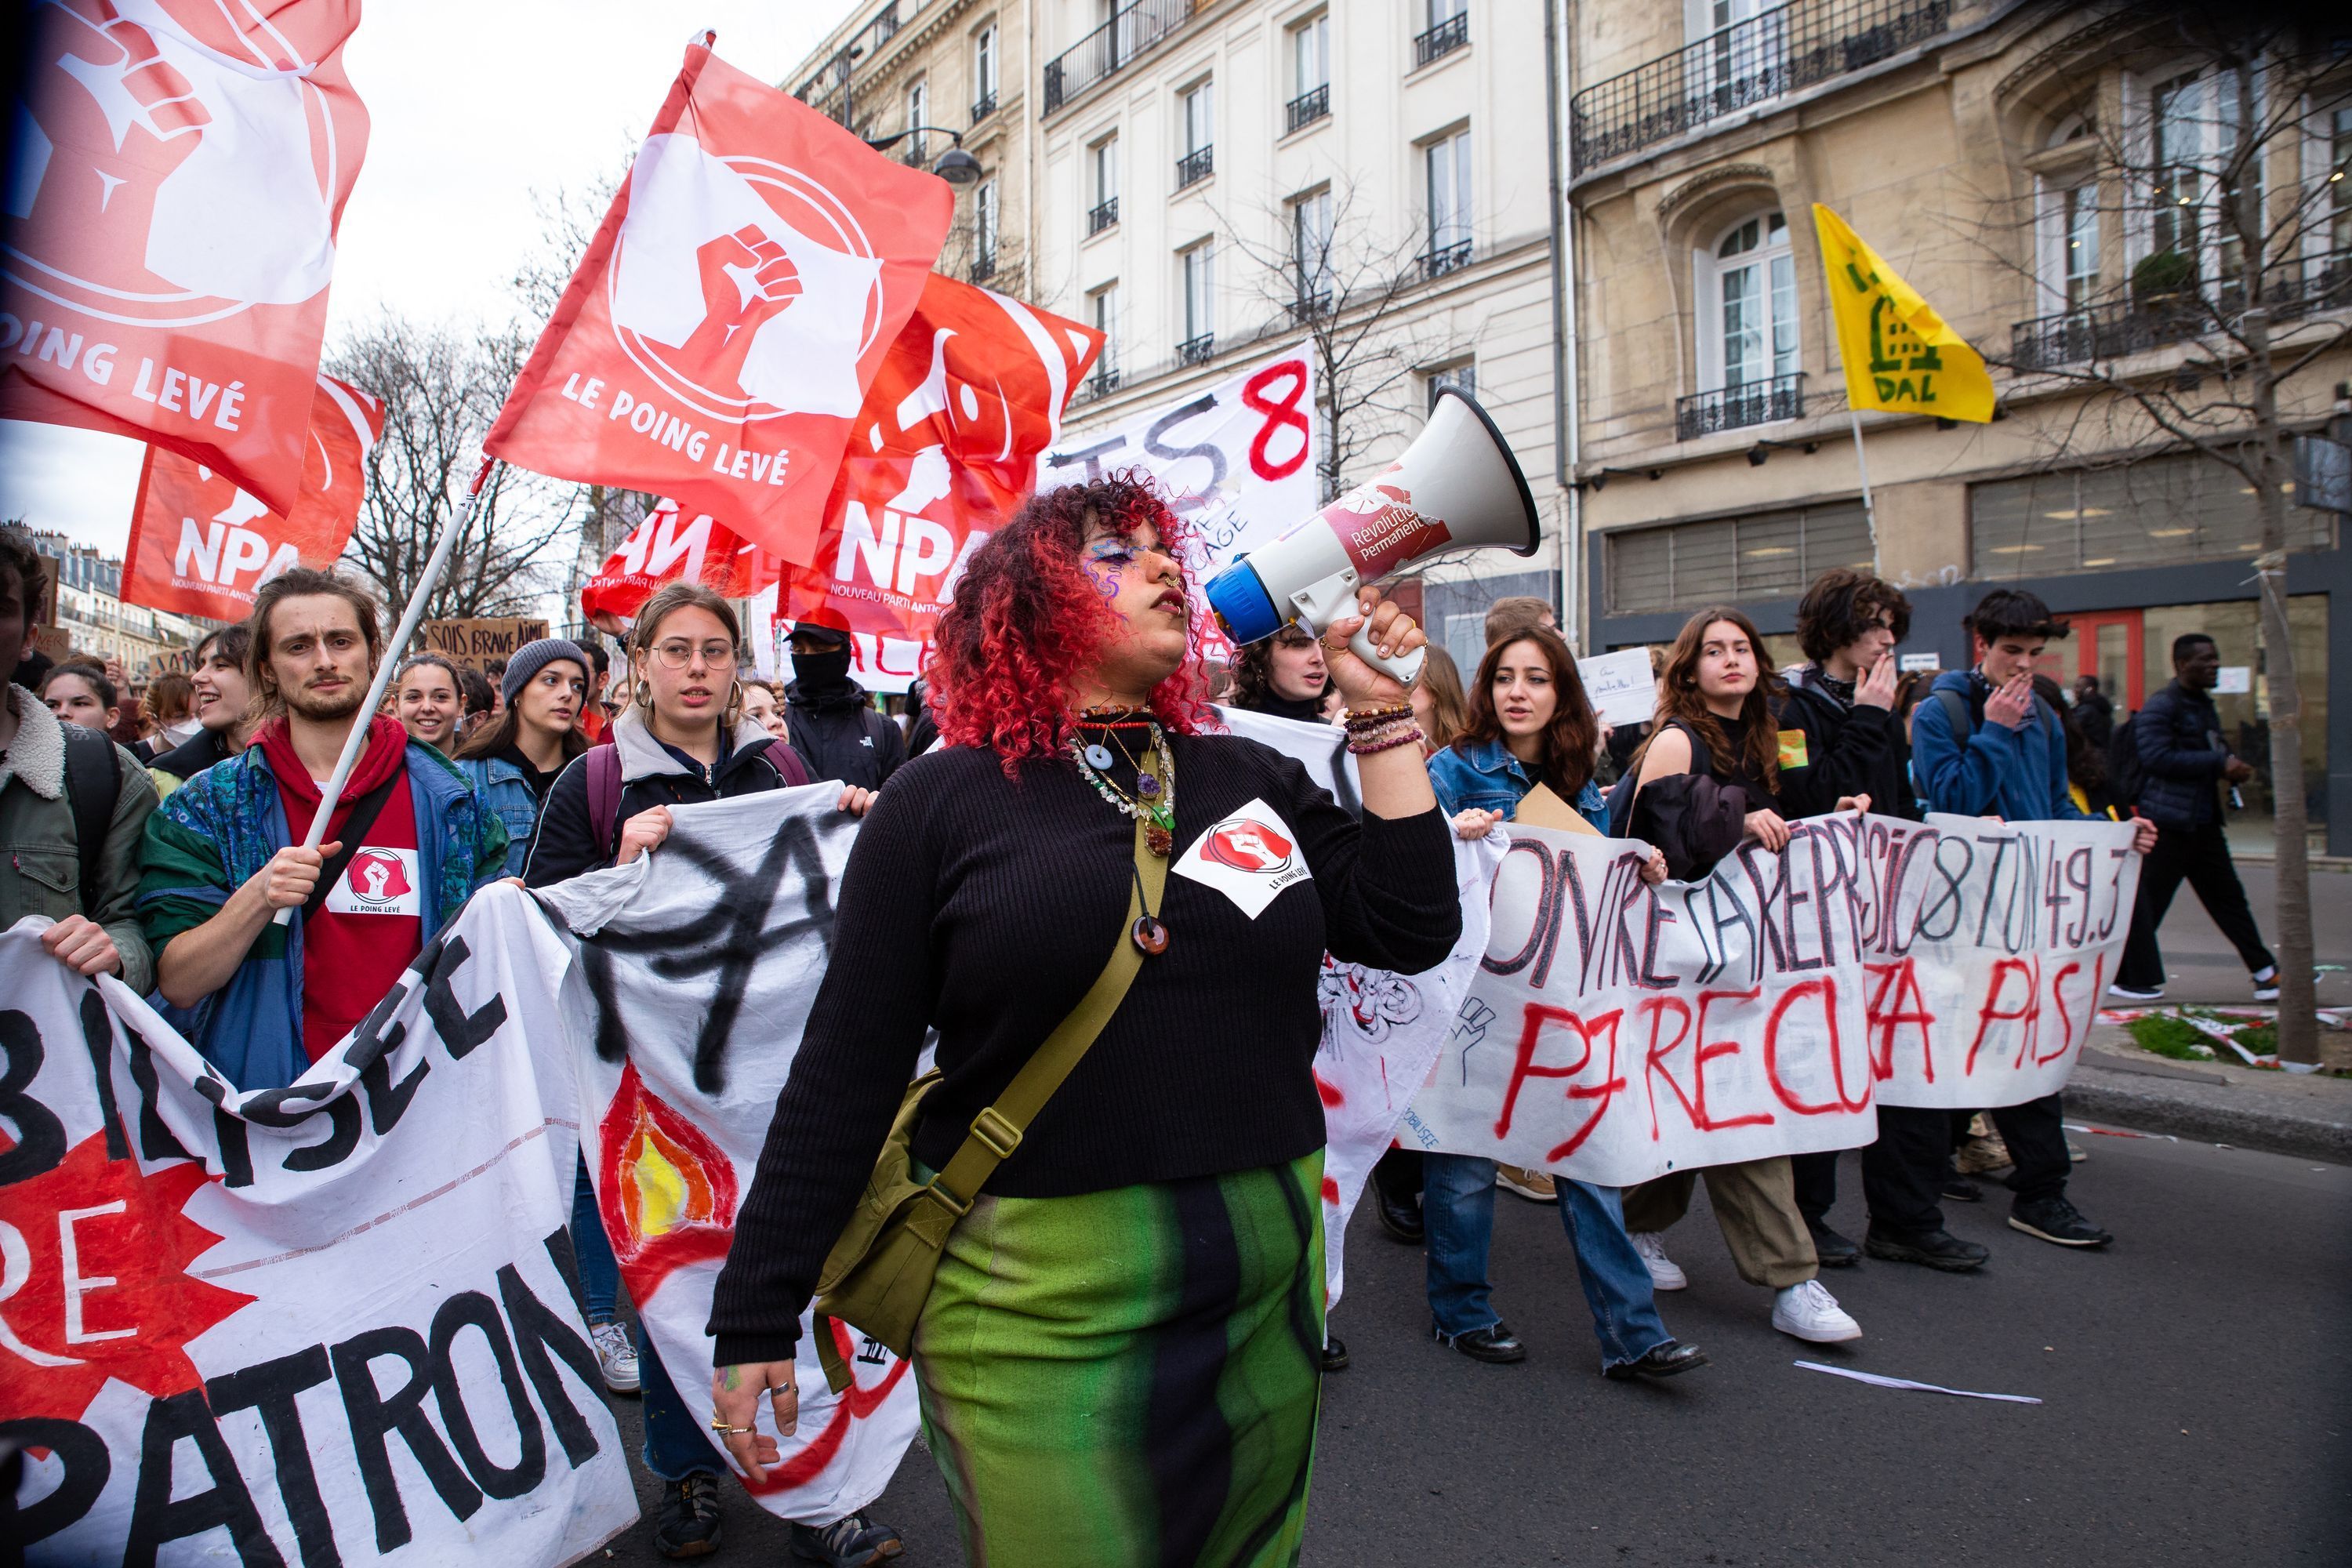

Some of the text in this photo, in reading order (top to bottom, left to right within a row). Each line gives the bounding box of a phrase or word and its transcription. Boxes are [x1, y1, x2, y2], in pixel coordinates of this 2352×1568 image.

[132, 357, 245, 432] LEVÉ
[1874, 375, 1936, 402] DAL
[561, 372, 789, 486] LE POING LEVÉ
[1242, 359, 1310, 481] 8
[1360, 516, 1425, 561] Permanent
[830, 583, 881, 603] NOUVEAU
[883, 593, 910, 610] PARTI
[430, 623, 467, 655] SOIS
[472, 630, 514, 655] BRAVE
[1269, 879, 1282, 891] LE
[384, 905, 401, 913] LEVÉ
[1403, 1107, 1439, 1150] OBILISEE
